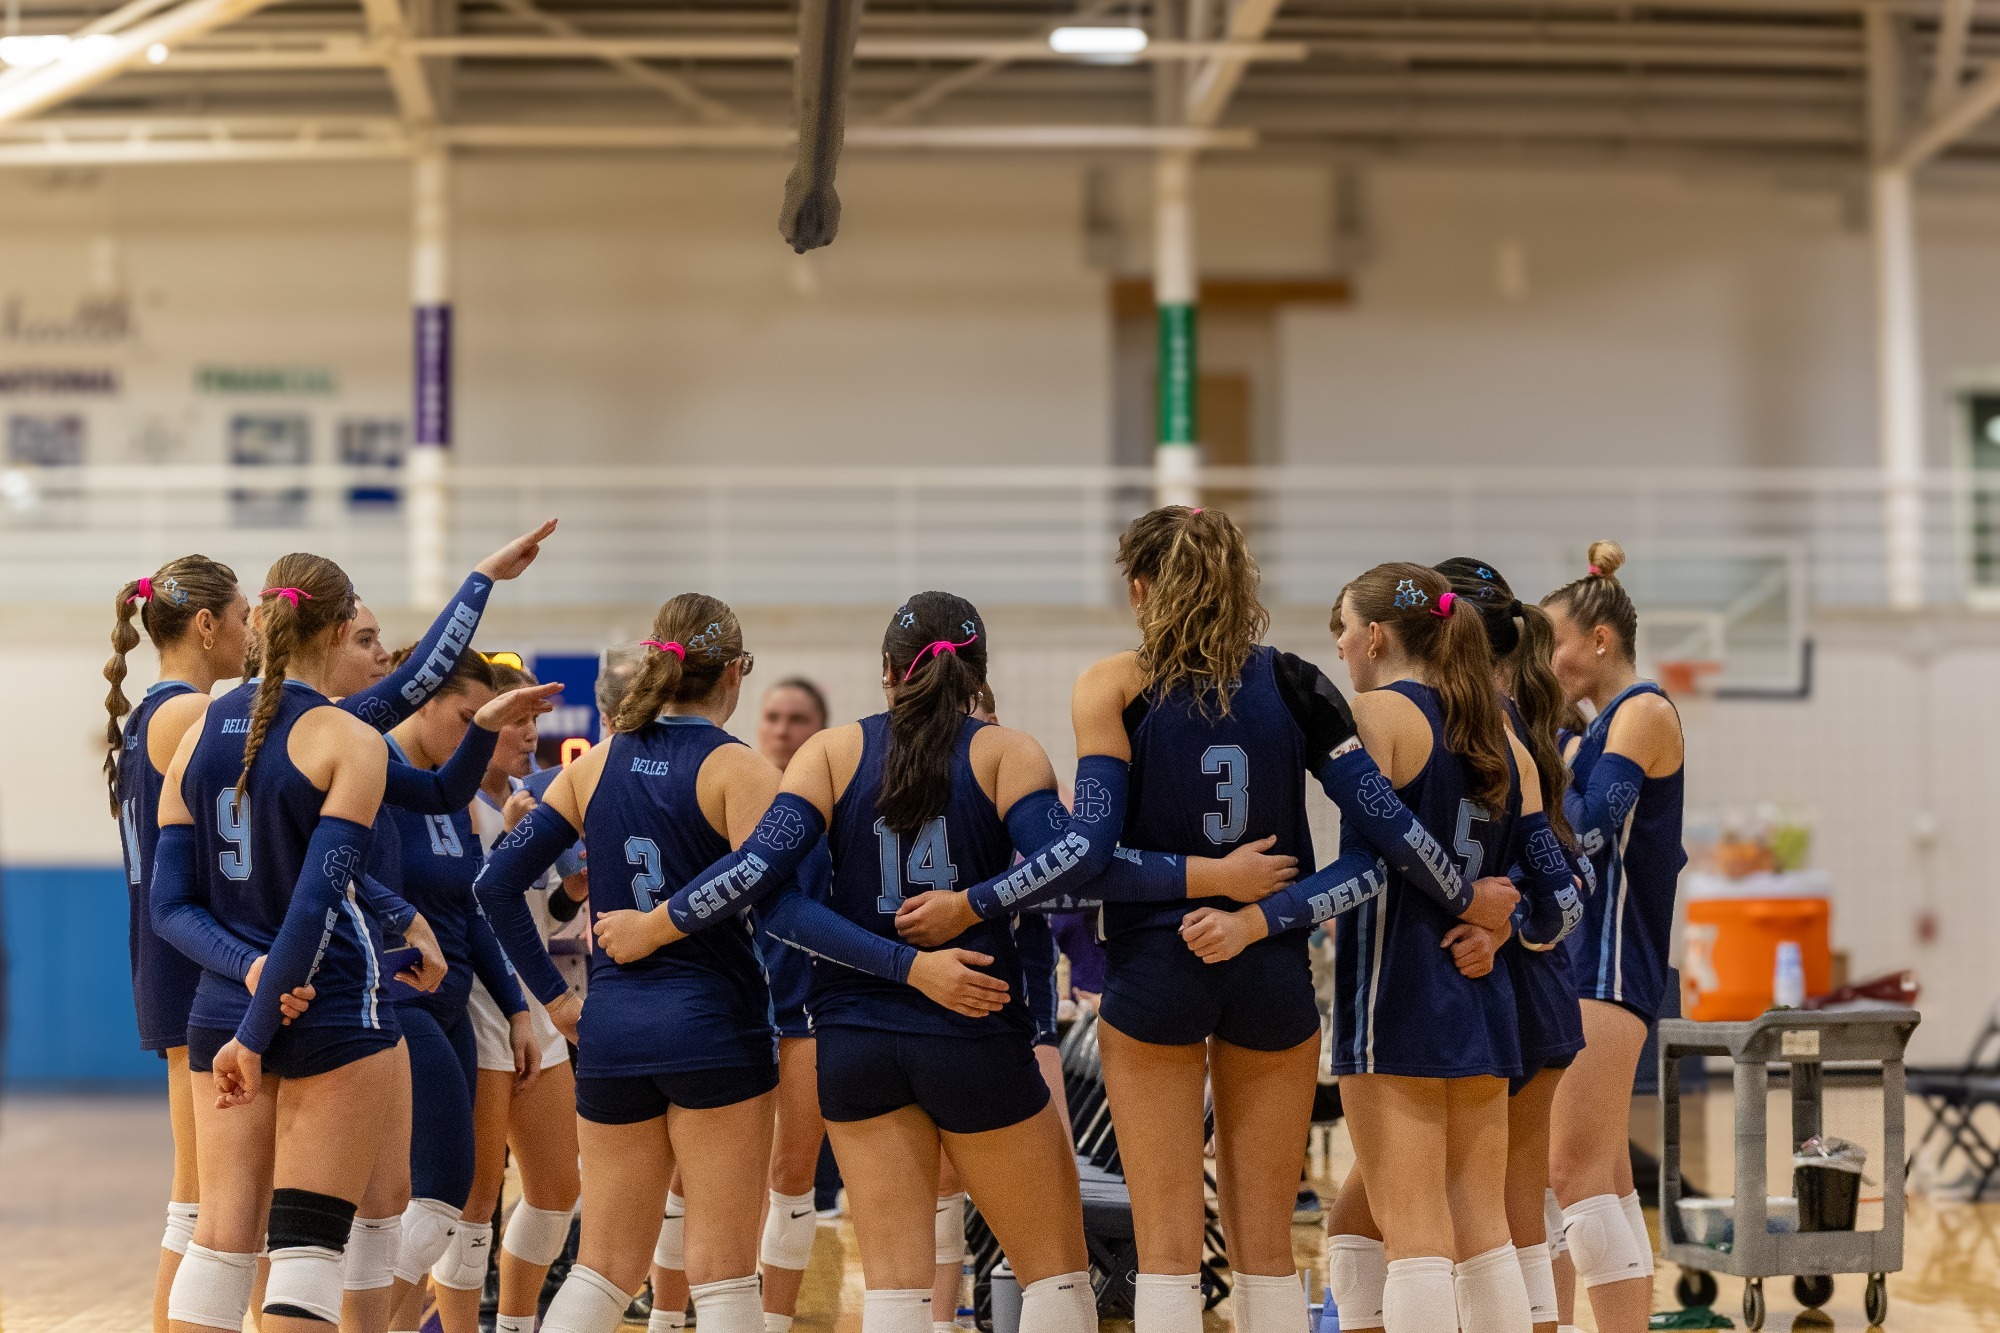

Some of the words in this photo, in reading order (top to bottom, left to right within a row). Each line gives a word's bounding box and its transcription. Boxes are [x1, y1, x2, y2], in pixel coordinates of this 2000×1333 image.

[401, 601, 479, 705] BELLES
[630, 756, 669, 776] BELLES
[1201, 744, 1249, 845] 3
[217, 787, 252, 880] 9
[624, 835, 665, 913] 2
[873, 816, 959, 913] 14
[992, 831, 1090, 907] BELLES
[1403, 818, 1463, 900] BELLES
[1453, 798, 1490, 883] 5
[687, 851, 770, 919] BELLES
[1307, 857, 1387, 924] BELL
